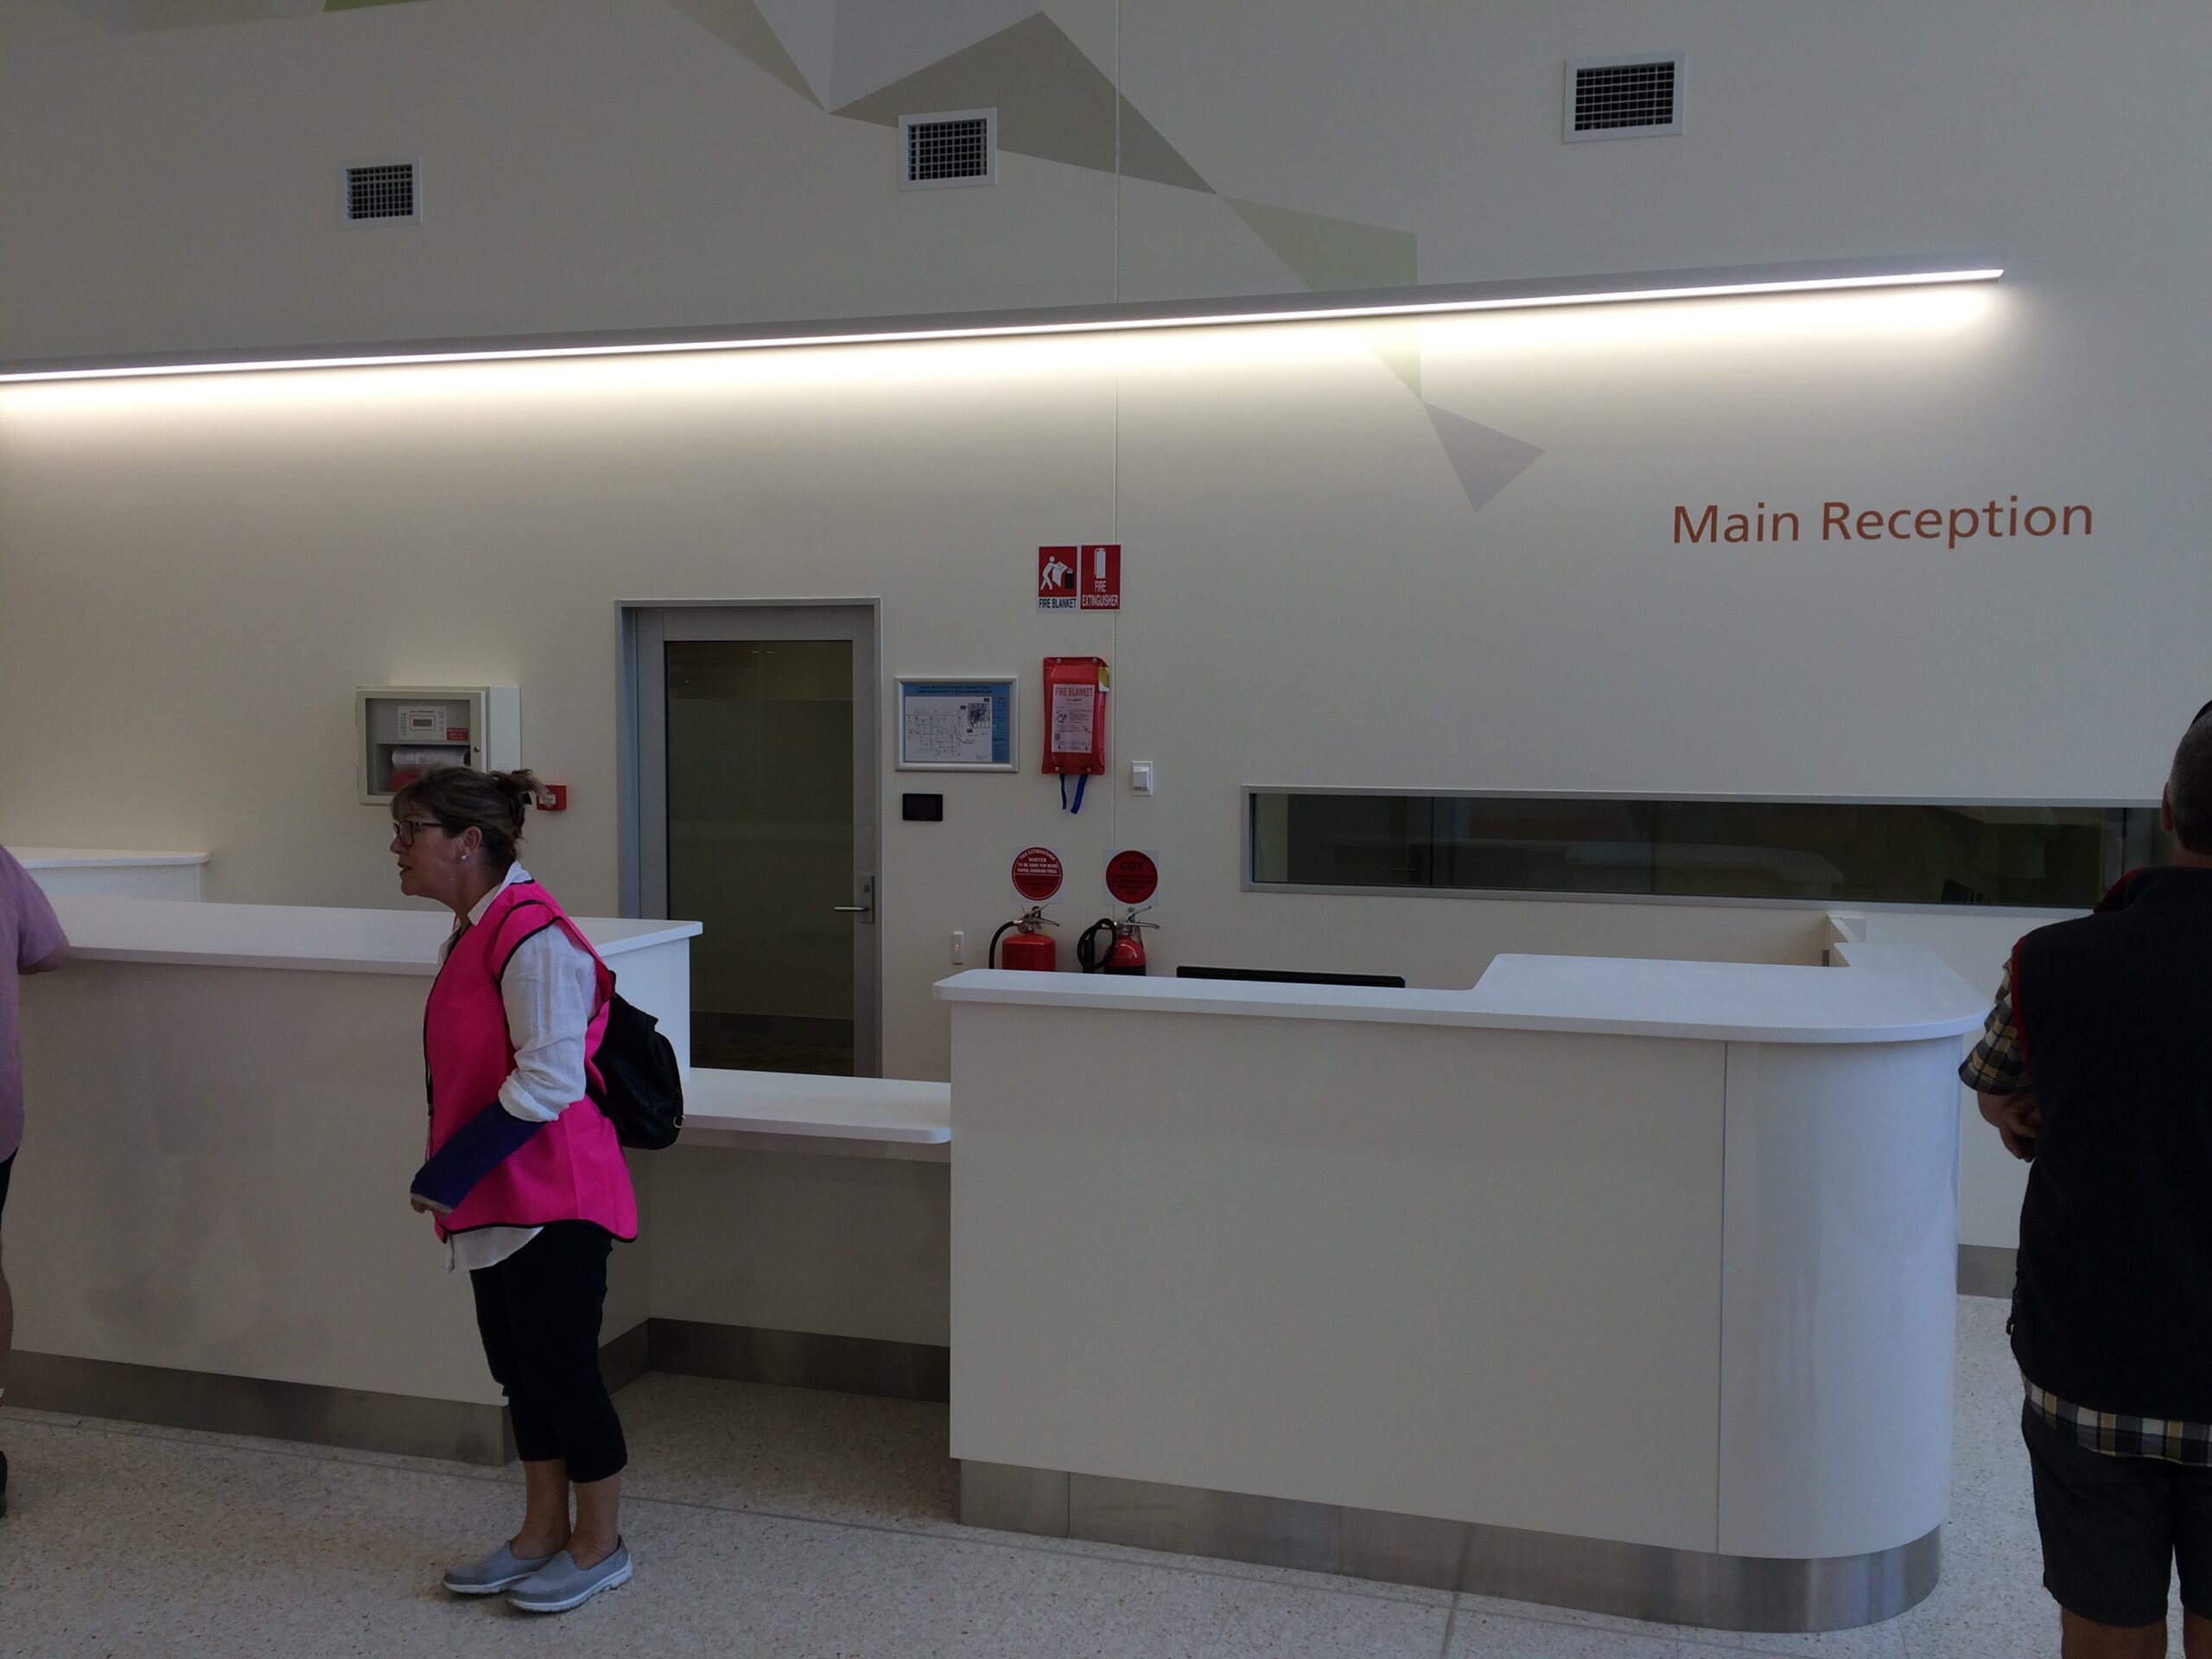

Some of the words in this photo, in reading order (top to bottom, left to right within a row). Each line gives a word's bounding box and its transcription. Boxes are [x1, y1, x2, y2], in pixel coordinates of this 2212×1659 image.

[1672, 501, 1799, 543] Main
[1822, 496, 2092, 550] Reception
[1095, 581, 1106, 593] FIRE
[1039, 598, 1051, 608] FIRE
[1052, 598, 1077, 609] BLANKET
[1082, 594, 1119, 607] EXTINGUISHER
[1055, 687, 1068, 696] FIRE
[1068, 687, 1093, 697] BLANKET
